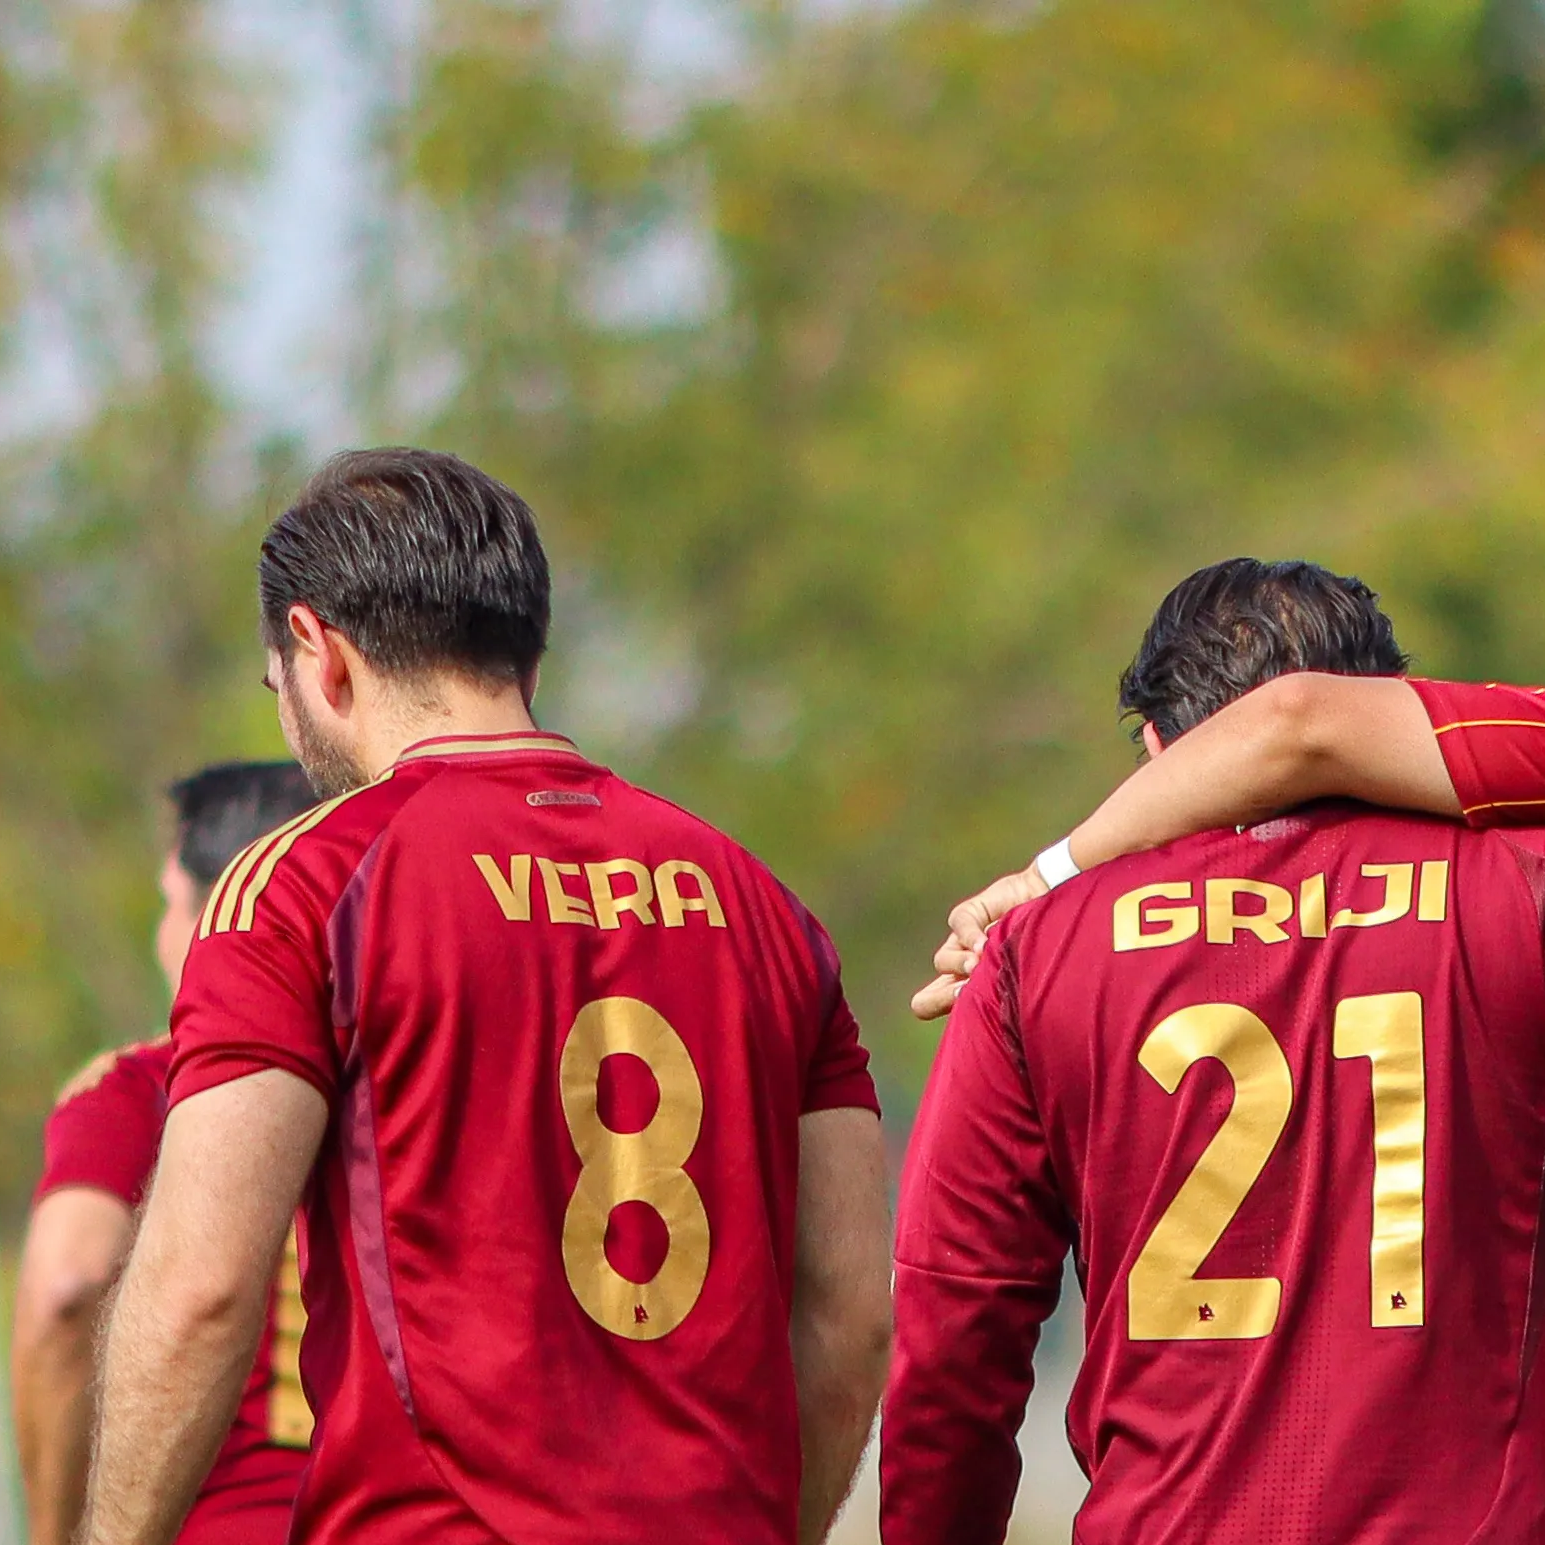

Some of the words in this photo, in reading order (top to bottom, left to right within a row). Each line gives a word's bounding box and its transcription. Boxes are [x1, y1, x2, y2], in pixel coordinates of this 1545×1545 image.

[472, 853, 728, 930] VERA
[1112, 860, 1449, 953] GRIJI
[559, 996, 711, 1341] 8
[1128, 991, 1426, 1341] 21
